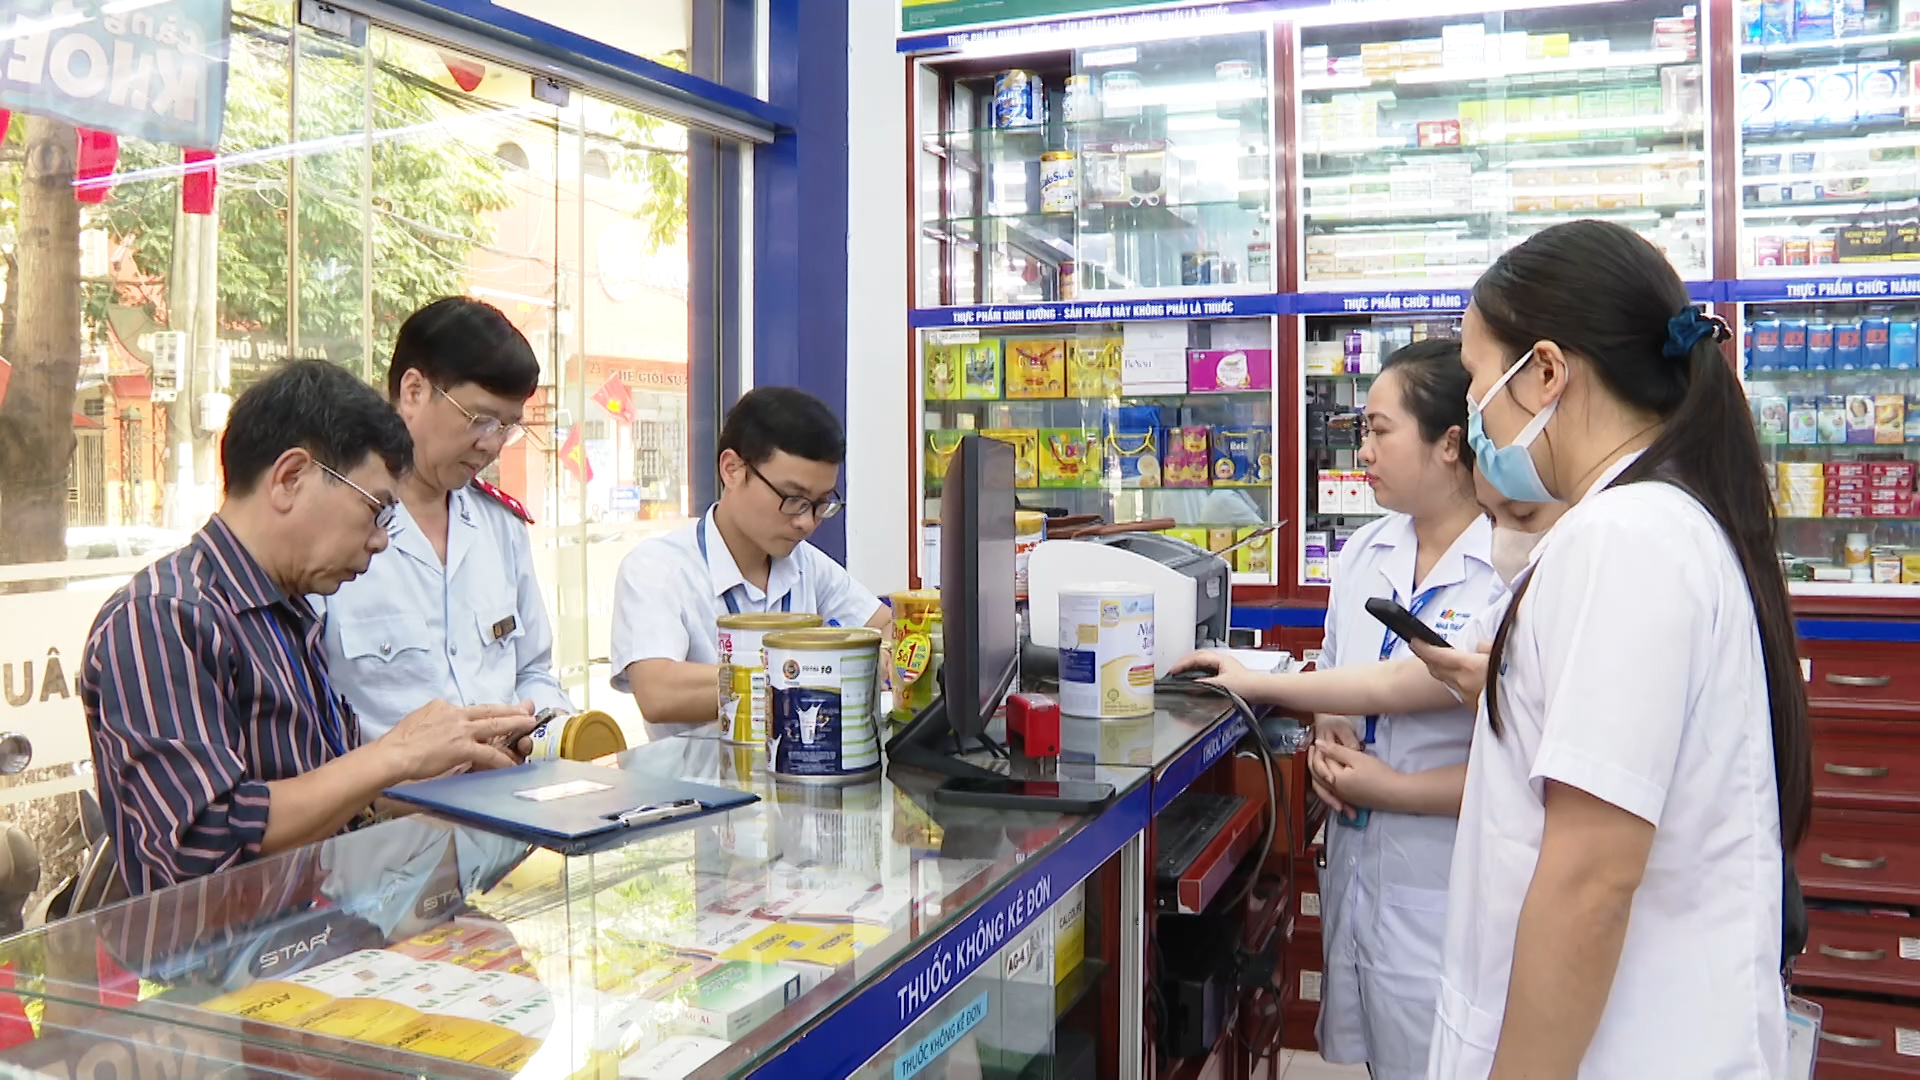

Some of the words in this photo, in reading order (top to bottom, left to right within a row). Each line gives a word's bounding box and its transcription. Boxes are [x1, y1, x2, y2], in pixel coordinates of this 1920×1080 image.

[1343, 297, 1369, 313] THỰC
[1371, 293, 1401, 310] PHẨM
[1402, 293, 1430, 308] CHỨC
[1432, 292, 1461, 308] NĂNG
[1786, 282, 1816, 300] THỰC
[1818, 276, 1853, 296] PHẨM
[1856, 277, 1888, 295] CHỨC
[953, 311, 974, 326] THỰC
[976, 306, 1001, 322] PHẨM
[1084, 302, 1111, 319] PHẨM
[1112, 303, 1131, 318] NÀY
[1133, 302, 1164, 317] KHÔNG
[1190, 299, 1202, 315] LÀ
[1203, 297, 1234, 314] THUỐC
[259, 927, 331, 970] STAR
[897, 944, 952, 1020] THUỐC
[955, 911, 1005, 974] KHÔNG
[1007, 889, 1024, 932] KÊ
[1027, 874, 1051, 917] ĐƠN
[902, 1042, 929, 1077] THUỐC
[930, 1023, 956, 1056] KHÔNG
